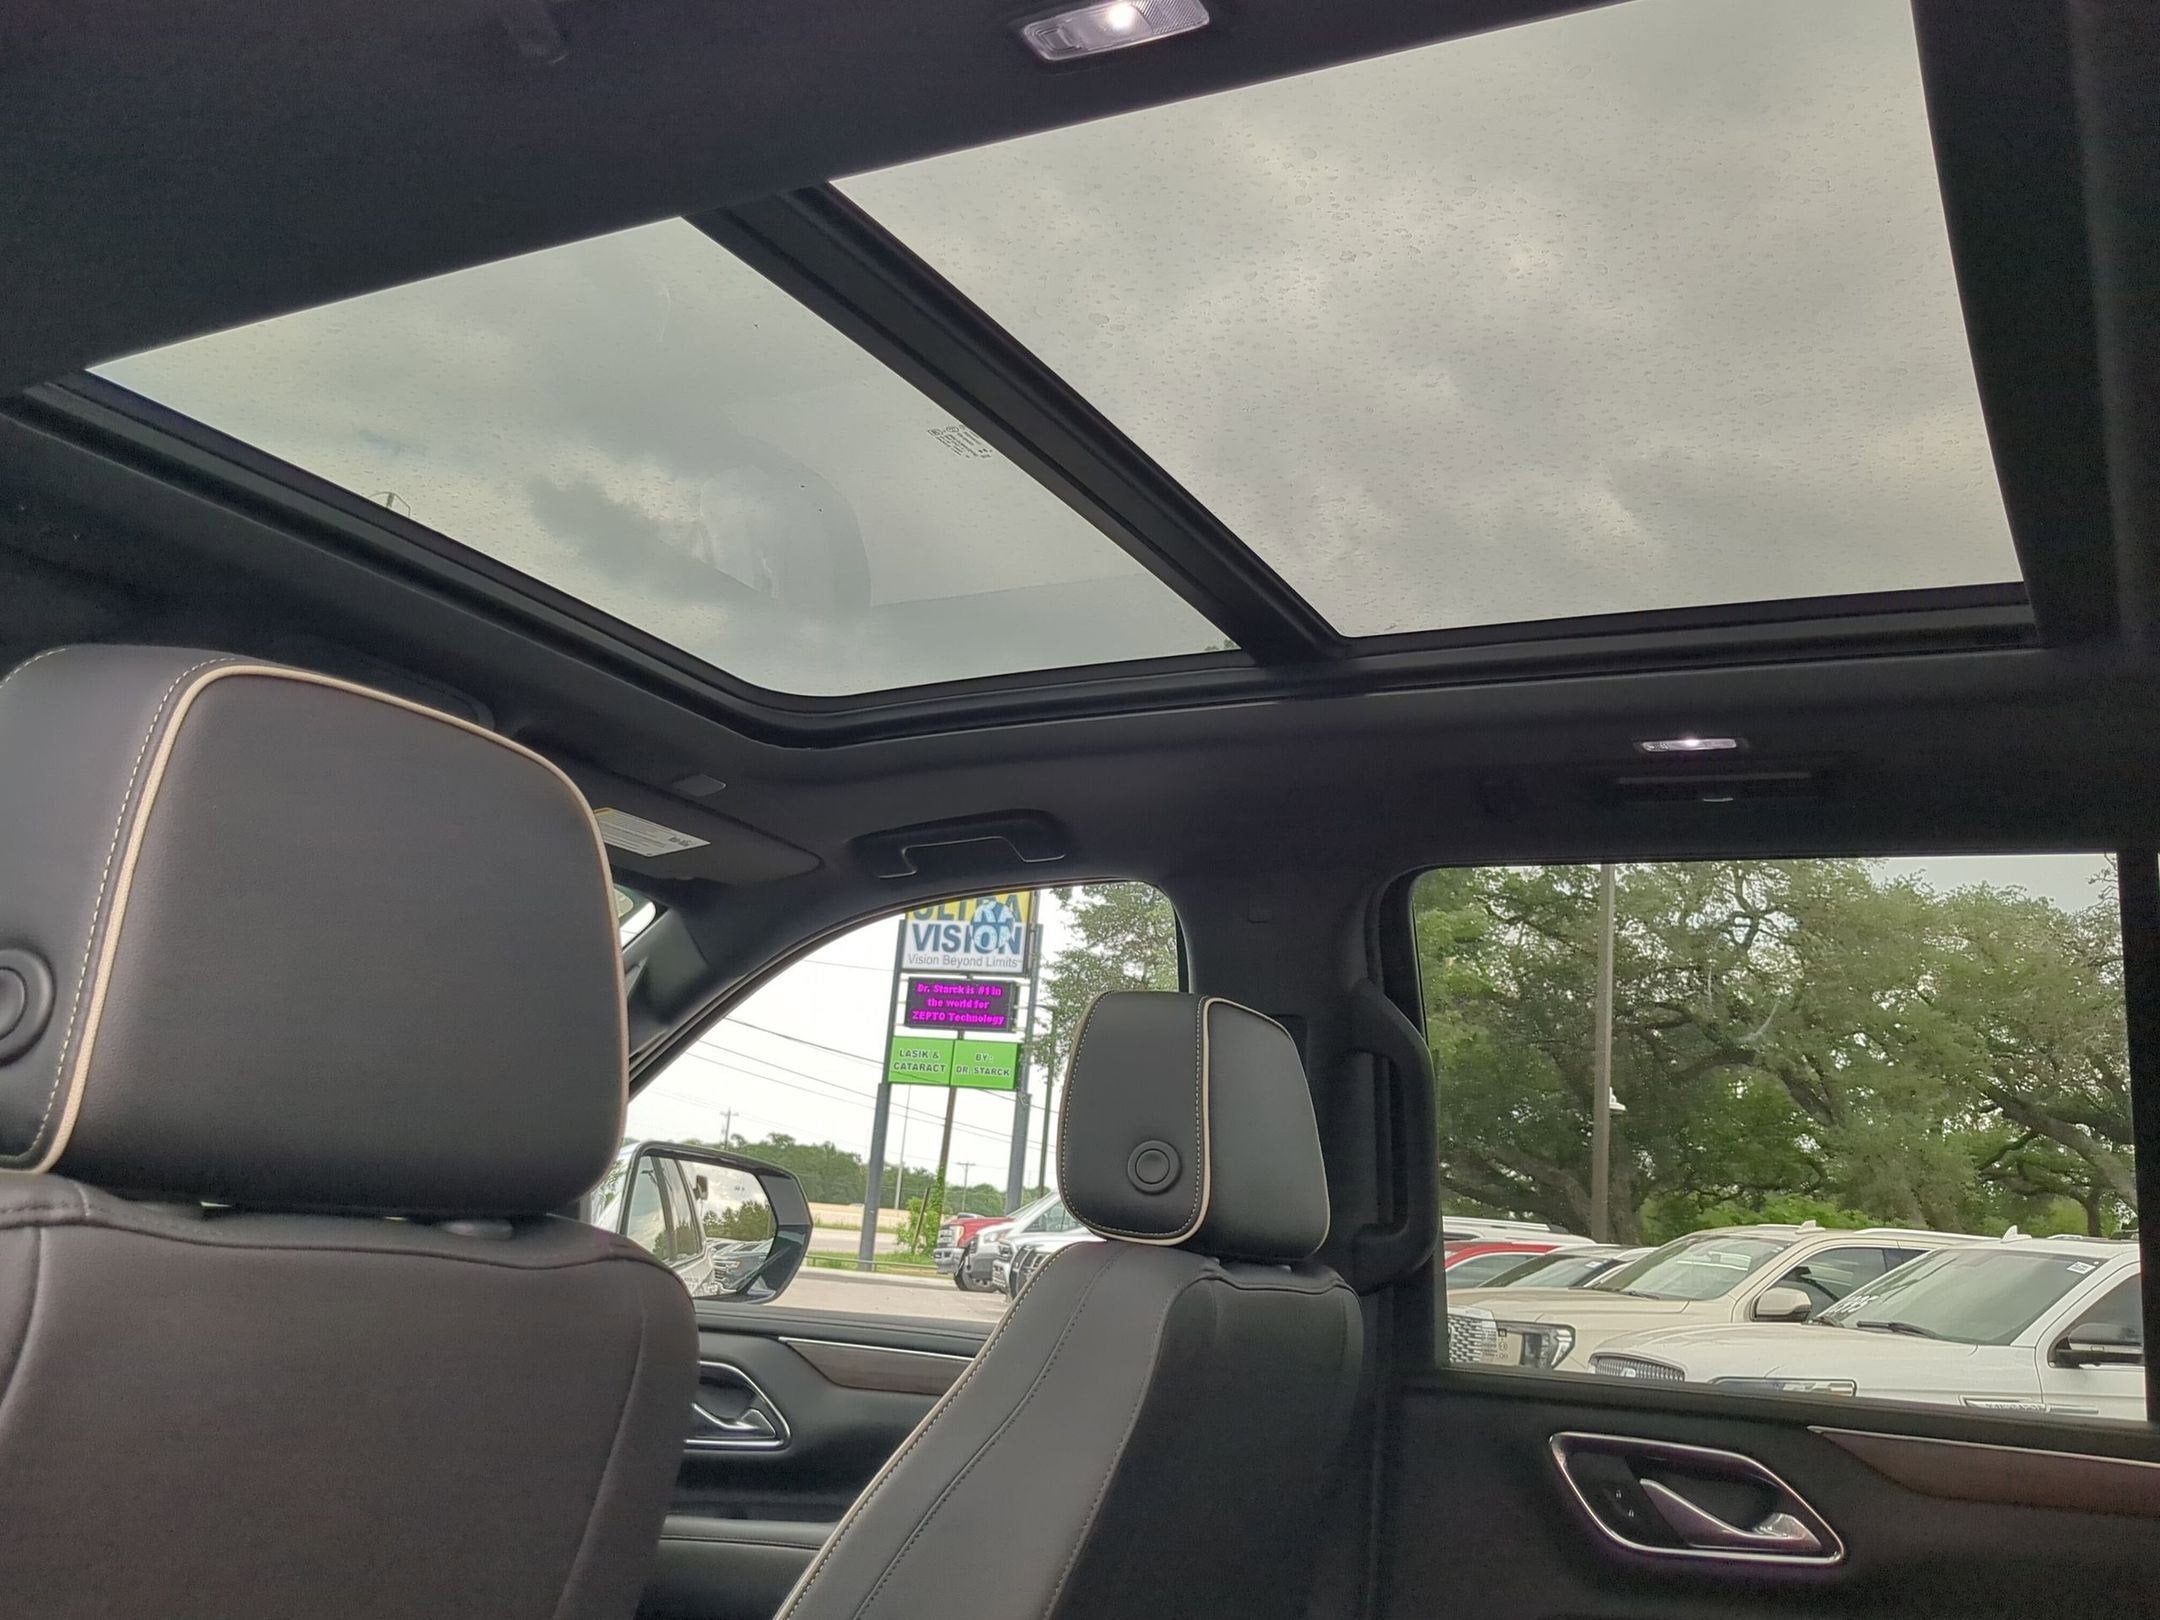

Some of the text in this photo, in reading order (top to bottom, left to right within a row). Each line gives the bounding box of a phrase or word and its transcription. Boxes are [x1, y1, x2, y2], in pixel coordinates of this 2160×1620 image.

[912, 923, 1022, 955] VISION
[908, 953, 1018, 968] Vision Beyond Limits
[917, 983, 1002, 996] Dr. Starck is #1 in
[927, 998, 990, 1009] the world for
[912, 1010, 1004, 1025] ZEPTO Technology
[900, 1049, 929, 1058] LASIK
[976, 1053, 993, 1061] BY:
[893, 1062, 946, 1072] CATARACT
[974, 1067, 1009, 1076] STARCK
